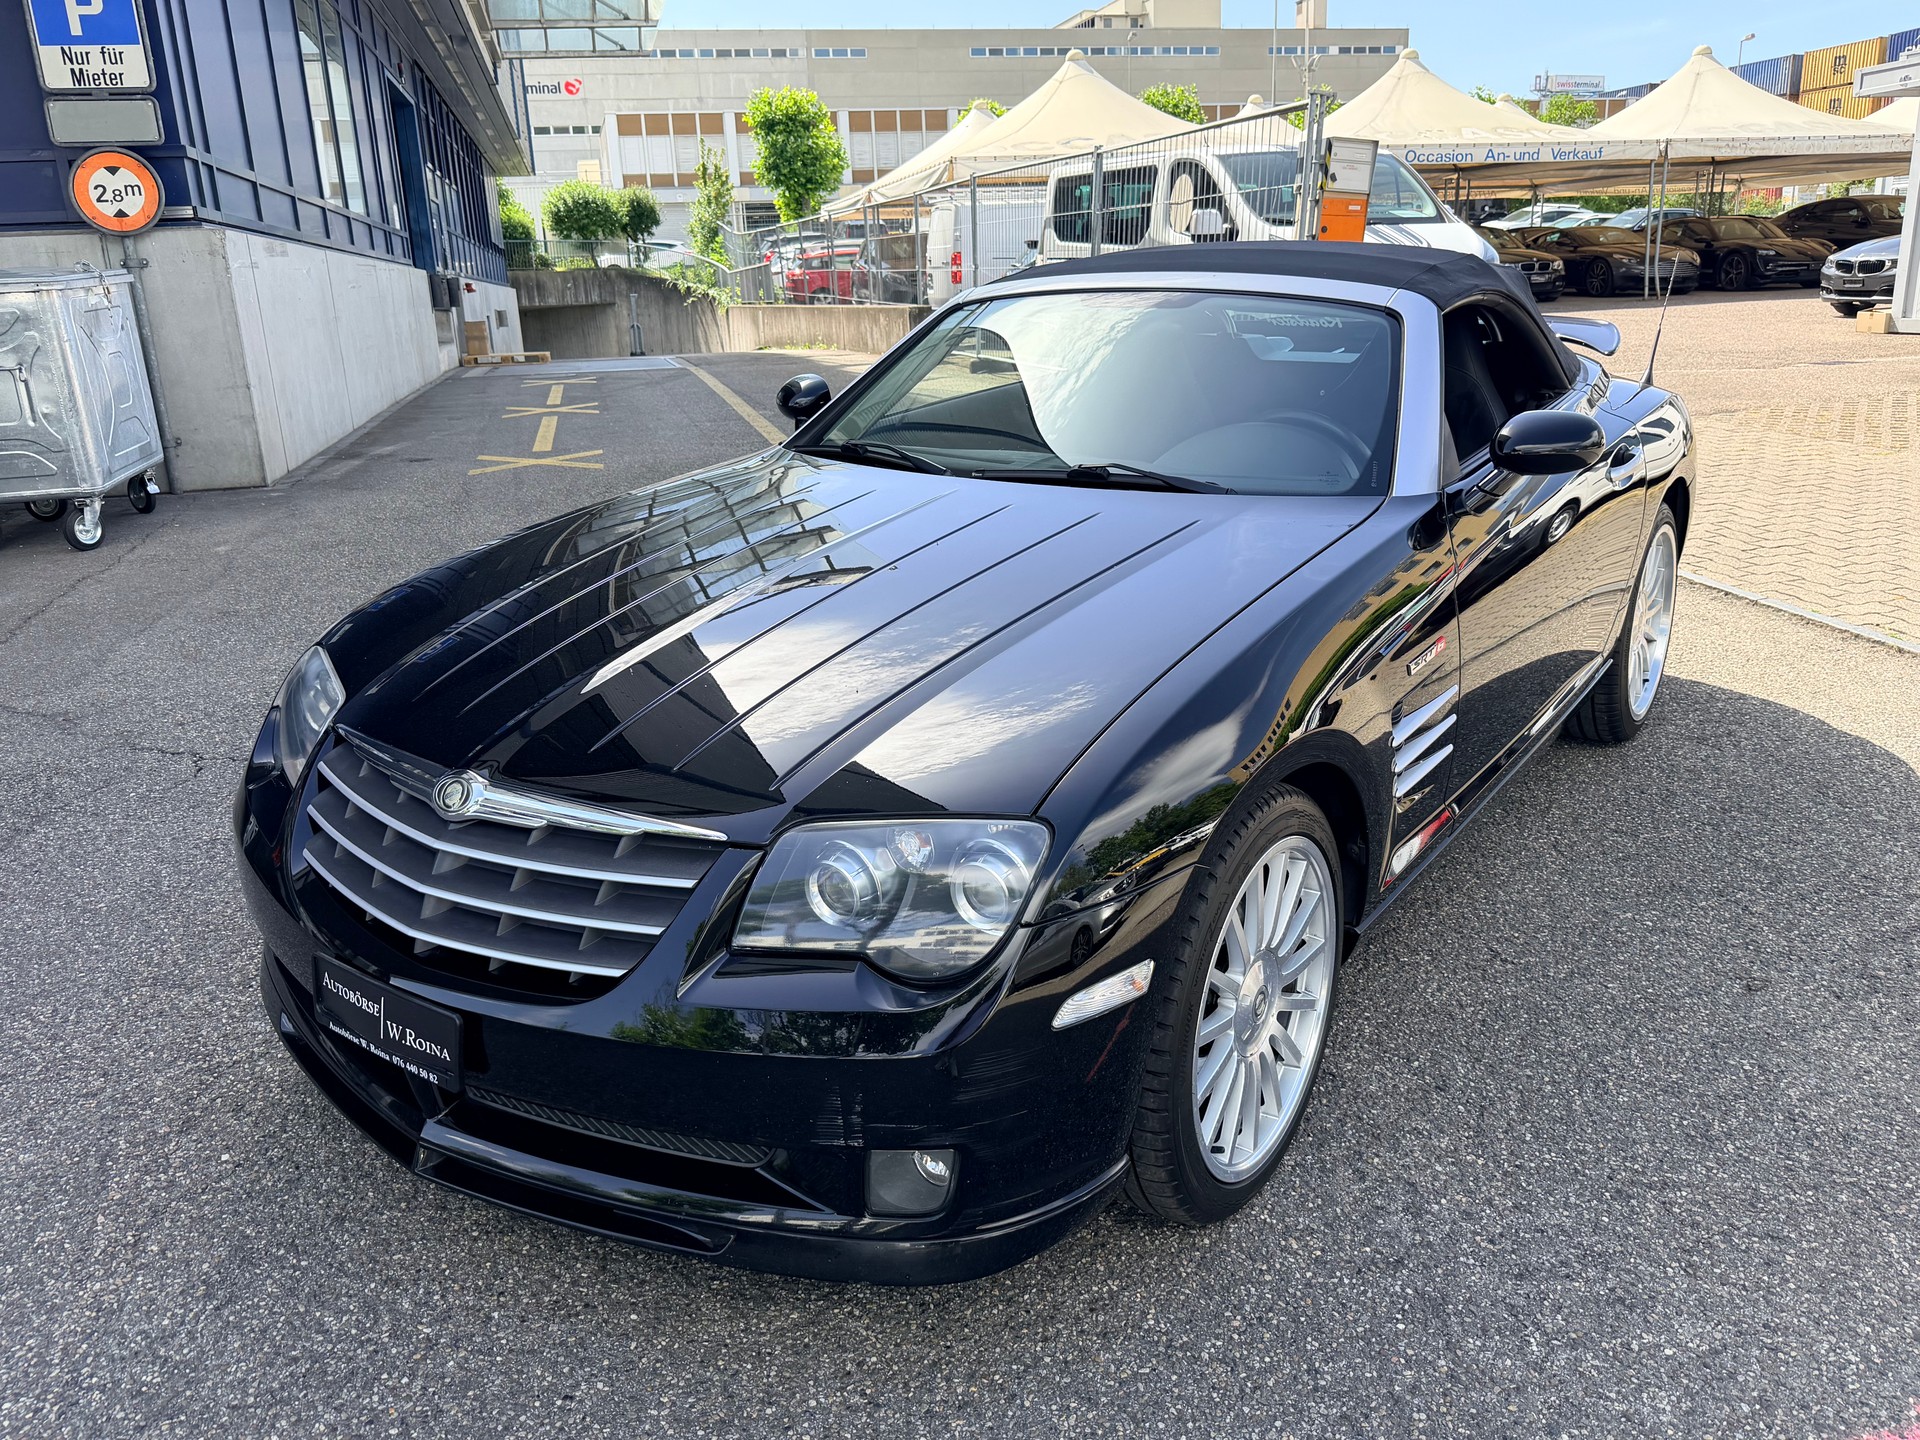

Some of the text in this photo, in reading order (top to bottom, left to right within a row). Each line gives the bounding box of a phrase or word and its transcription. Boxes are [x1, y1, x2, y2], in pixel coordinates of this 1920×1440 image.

[61, 46, 124, 66] Nur für
[70, 67, 124, 87] Mieter
[1404, 149, 1474, 163] Occasion
[1551, 146, 1604, 161] Verkauf
[322, 971, 380, 1016] AUTOBÖRSE
[329, 1021, 439, 1084] Autobörse W. Roina 076 440 50 82
